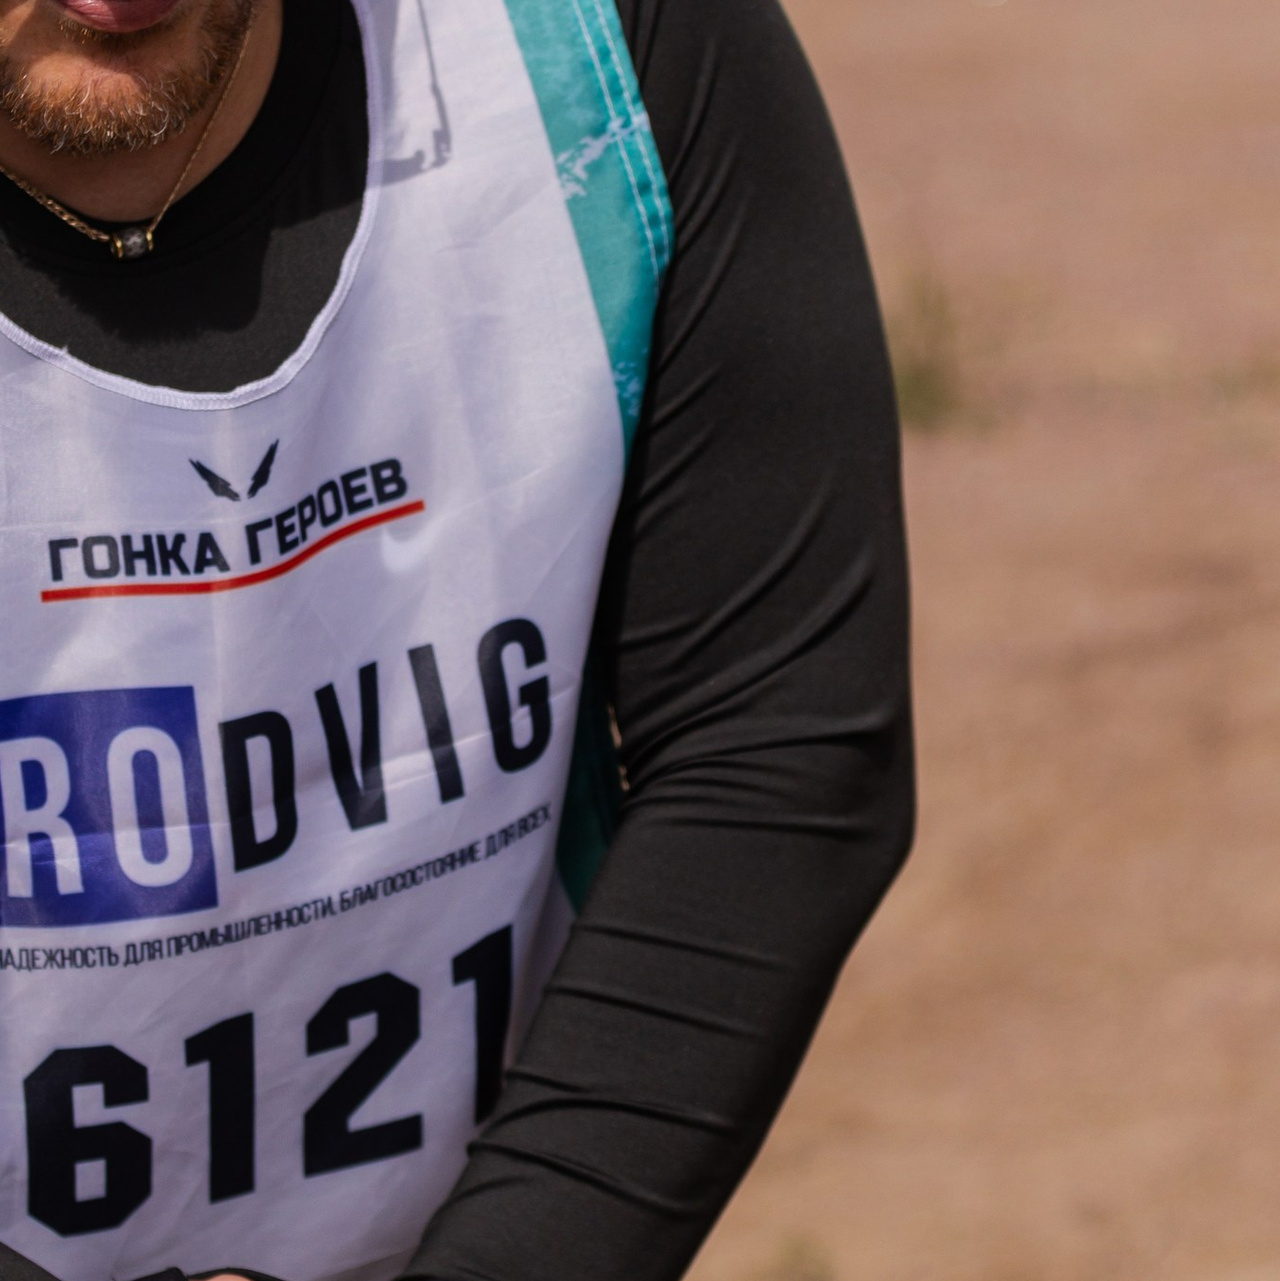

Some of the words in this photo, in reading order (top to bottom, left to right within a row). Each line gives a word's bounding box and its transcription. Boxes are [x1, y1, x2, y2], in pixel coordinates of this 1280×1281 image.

[48, 531, 230, 582] ГОНКА
[245, 458, 408, 566] ГЕРОЕВ
[122, 937, 163, 967] ДЛЯ
[339, 841, 481, 912] БЛАГОСОСТОЯНИЕ
[484, 823, 519, 860] ДЛЯ
[23, 924, 513, 1238] 6121
